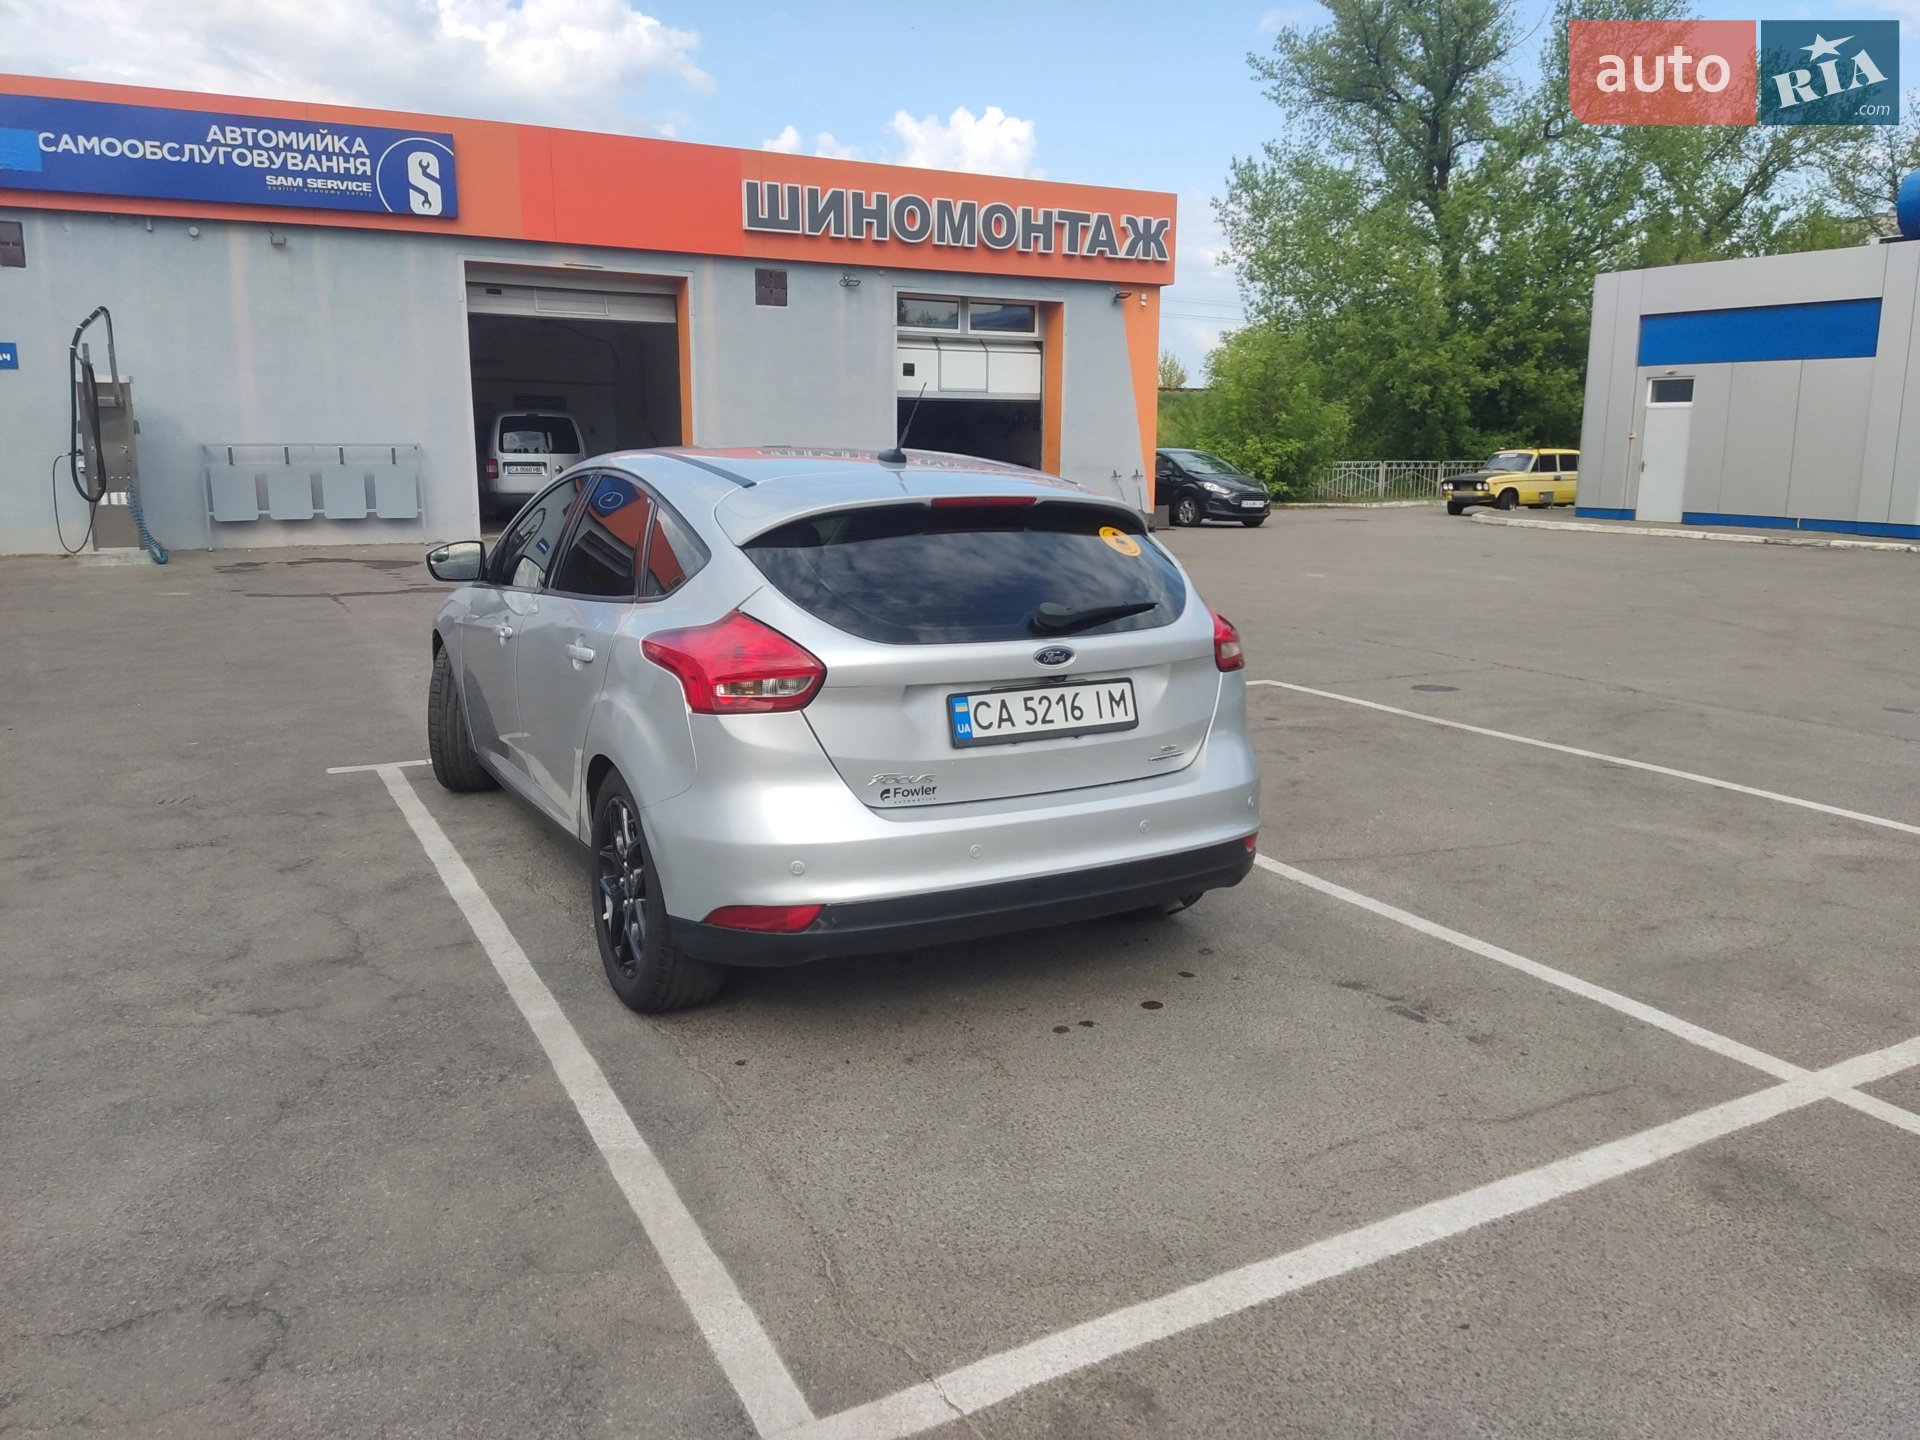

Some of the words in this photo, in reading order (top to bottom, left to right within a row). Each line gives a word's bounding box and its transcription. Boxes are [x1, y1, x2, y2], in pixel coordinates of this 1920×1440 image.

[206, 124, 369, 156] АВТОМИЙКА
[38, 132, 372, 176] САМООБСЛУГОВУВАННЯ
[265, 175, 303, 187] SAM
[306, 178, 373, 192] SERVICE
[304, 188, 341, 196] economy
[742, 179, 1170, 261] ШИНОМОНТАЖ
[1043, 650, 1067, 663] Ford
[973, 699, 1016, 731] CA
[1023, 692, 1084, 726] 5216
[1096, 688, 1128, 719] IM
[957, 723, 971, 734] UA
[893, 785, 937, 799] Fowler
